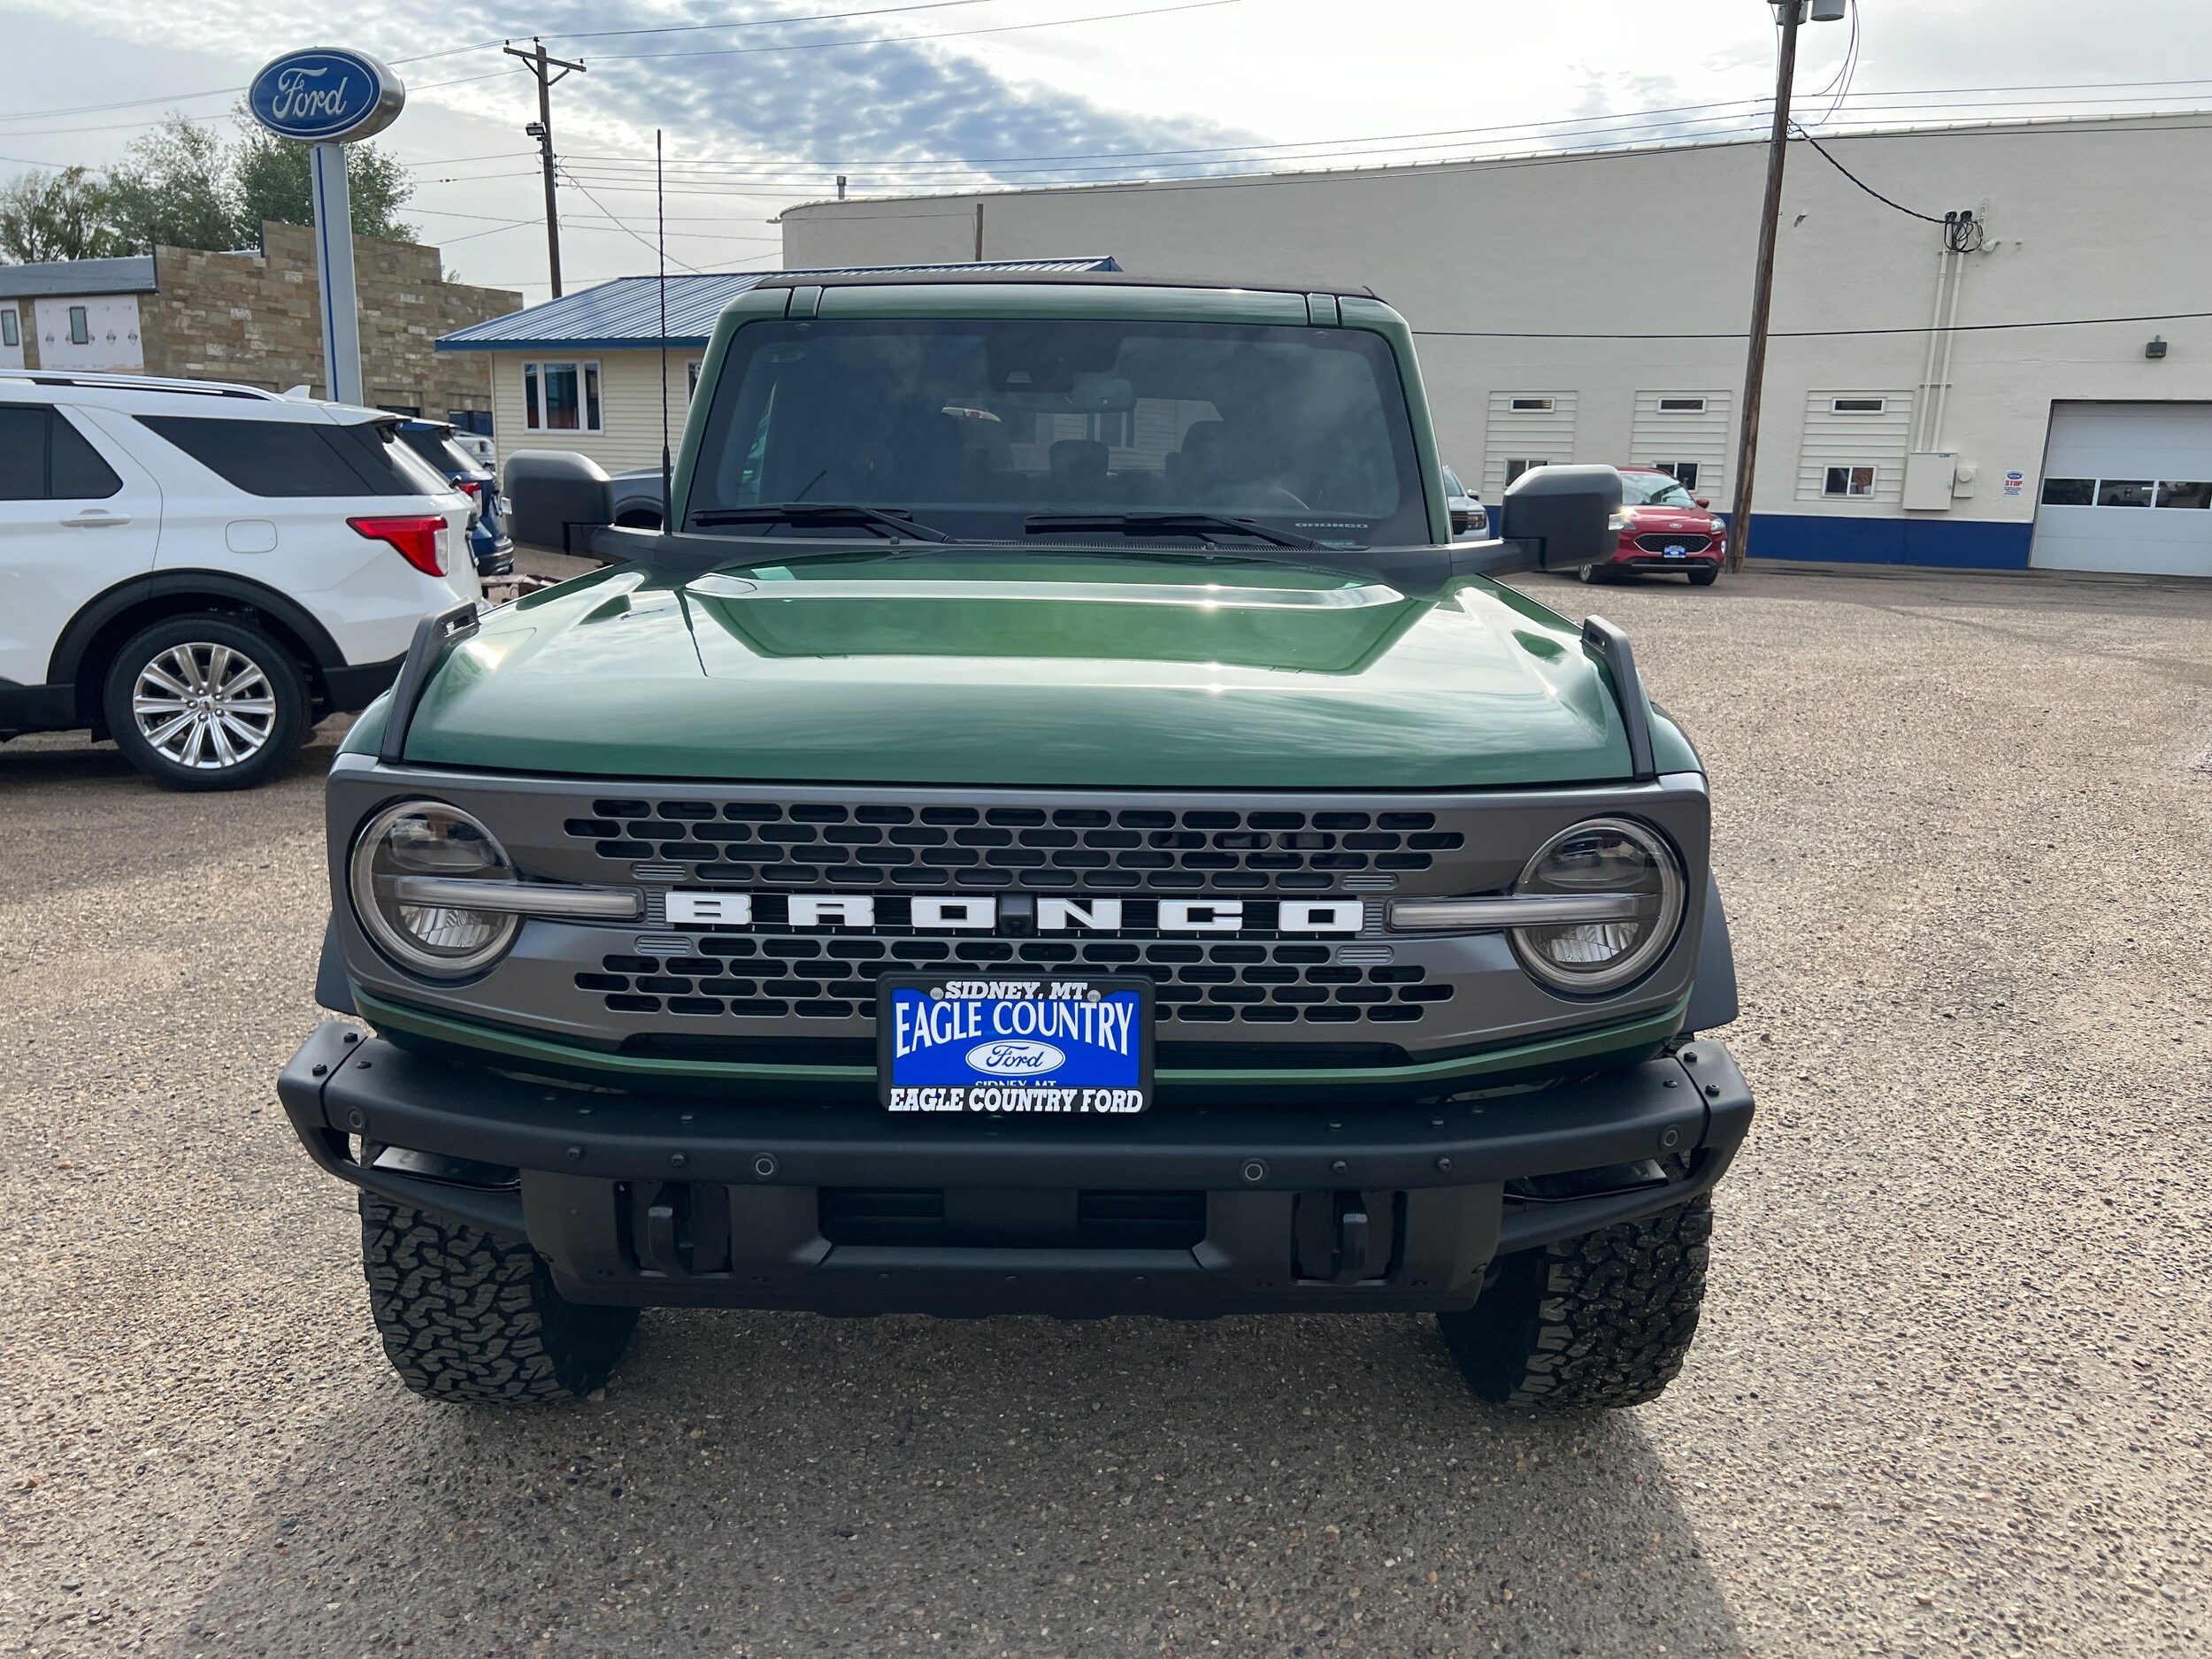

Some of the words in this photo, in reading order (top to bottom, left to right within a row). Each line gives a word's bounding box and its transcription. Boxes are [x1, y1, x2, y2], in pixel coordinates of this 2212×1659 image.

[272, 66, 349, 119] Ford
[664, 891, 1364, 932] BRONCO
[945, 980, 1044, 1001] SIDNEY,
[1048, 982, 1088, 1001] MT
[895, 1001, 982, 1059] EAGLE
[993, 1001, 1134, 1056] COUNTRY
[986, 1044, 1045, 1068] Ford
[888, 1087, 965, 1112] EAGLE
[968, 1087, 1078, 1112] COUNTRY
[1081, 1088, 1144, 1113] FORD
